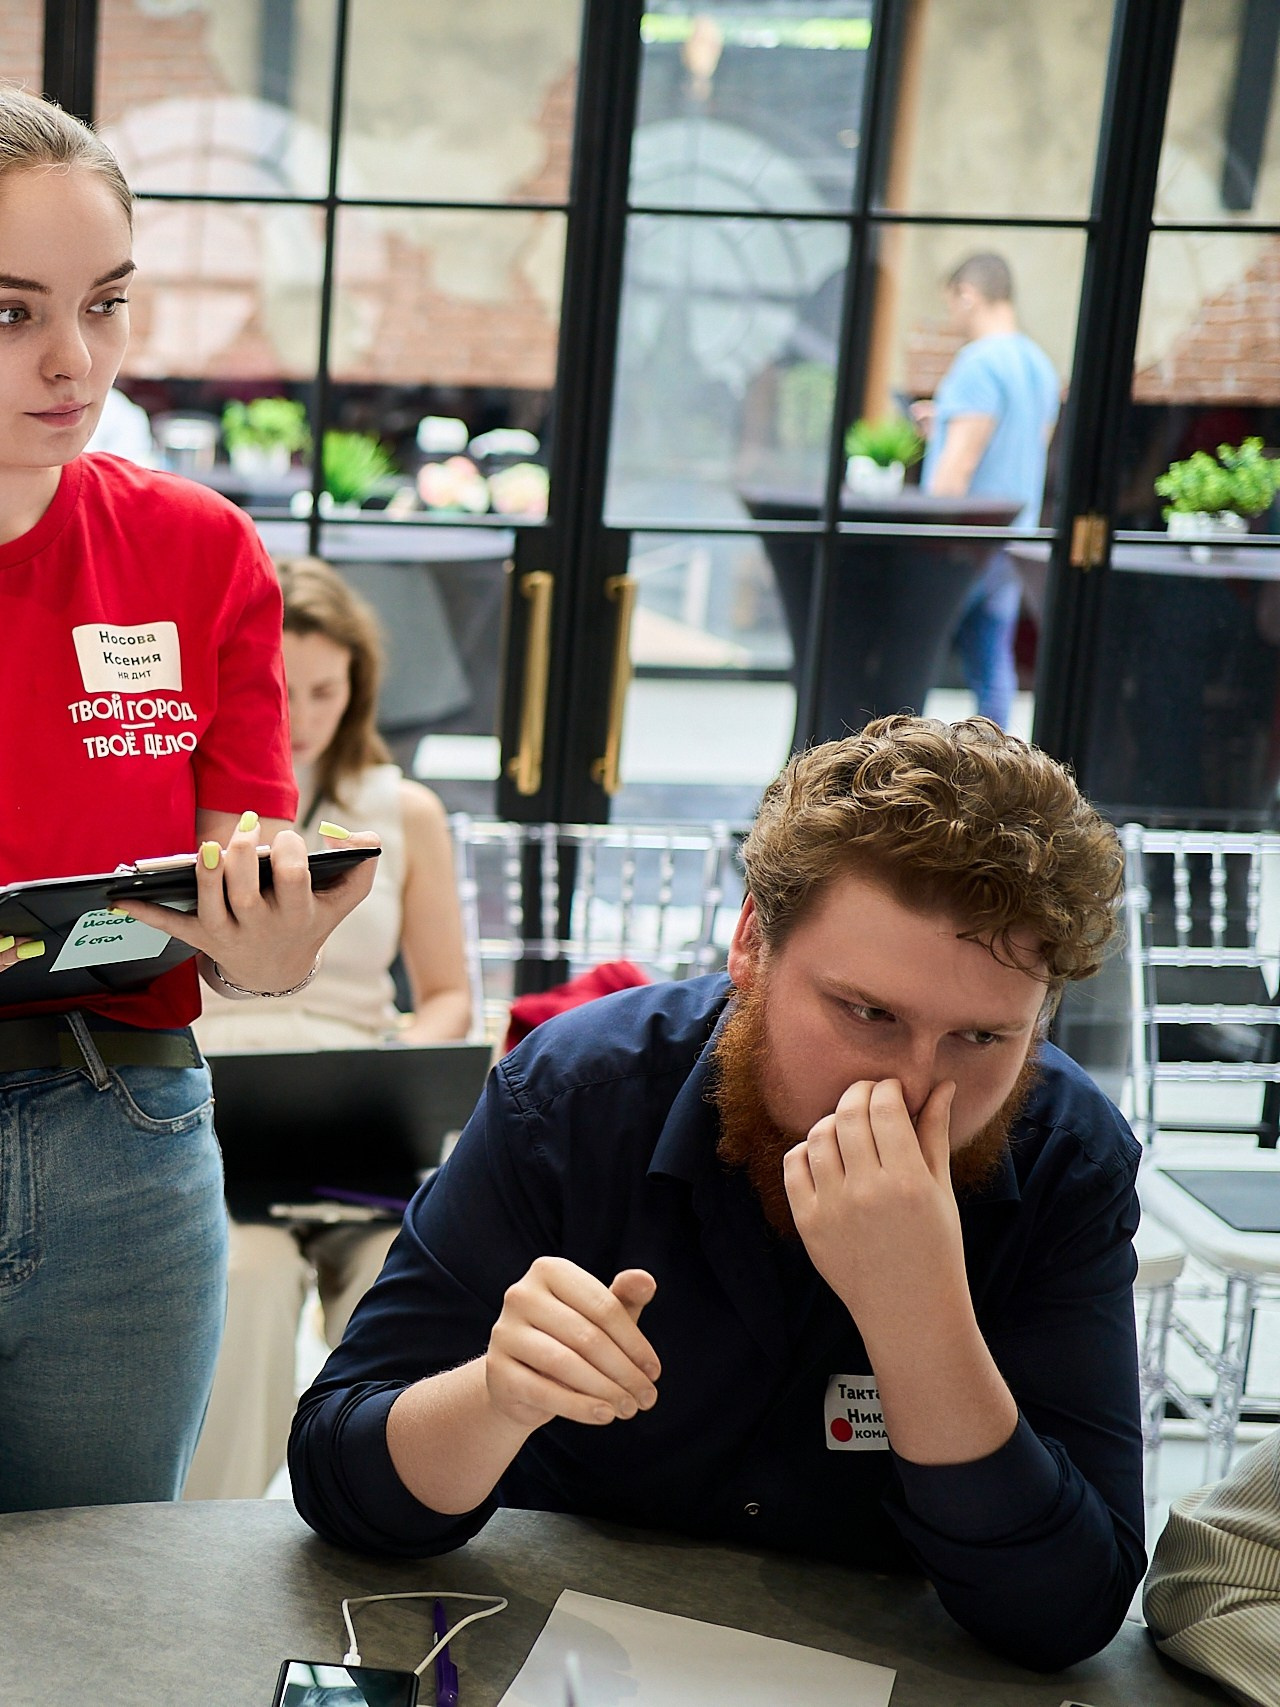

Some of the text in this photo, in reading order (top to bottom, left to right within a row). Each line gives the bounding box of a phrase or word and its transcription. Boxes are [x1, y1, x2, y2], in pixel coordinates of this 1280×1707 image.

[98, 630, 157, 646] Носова
[103, 651, 162, 667] Ксения
[68, 693, 198, 724] ТВОЙ ГОРОД
[82, 731, 198, 760] ТВОЁ ДЕЛО
